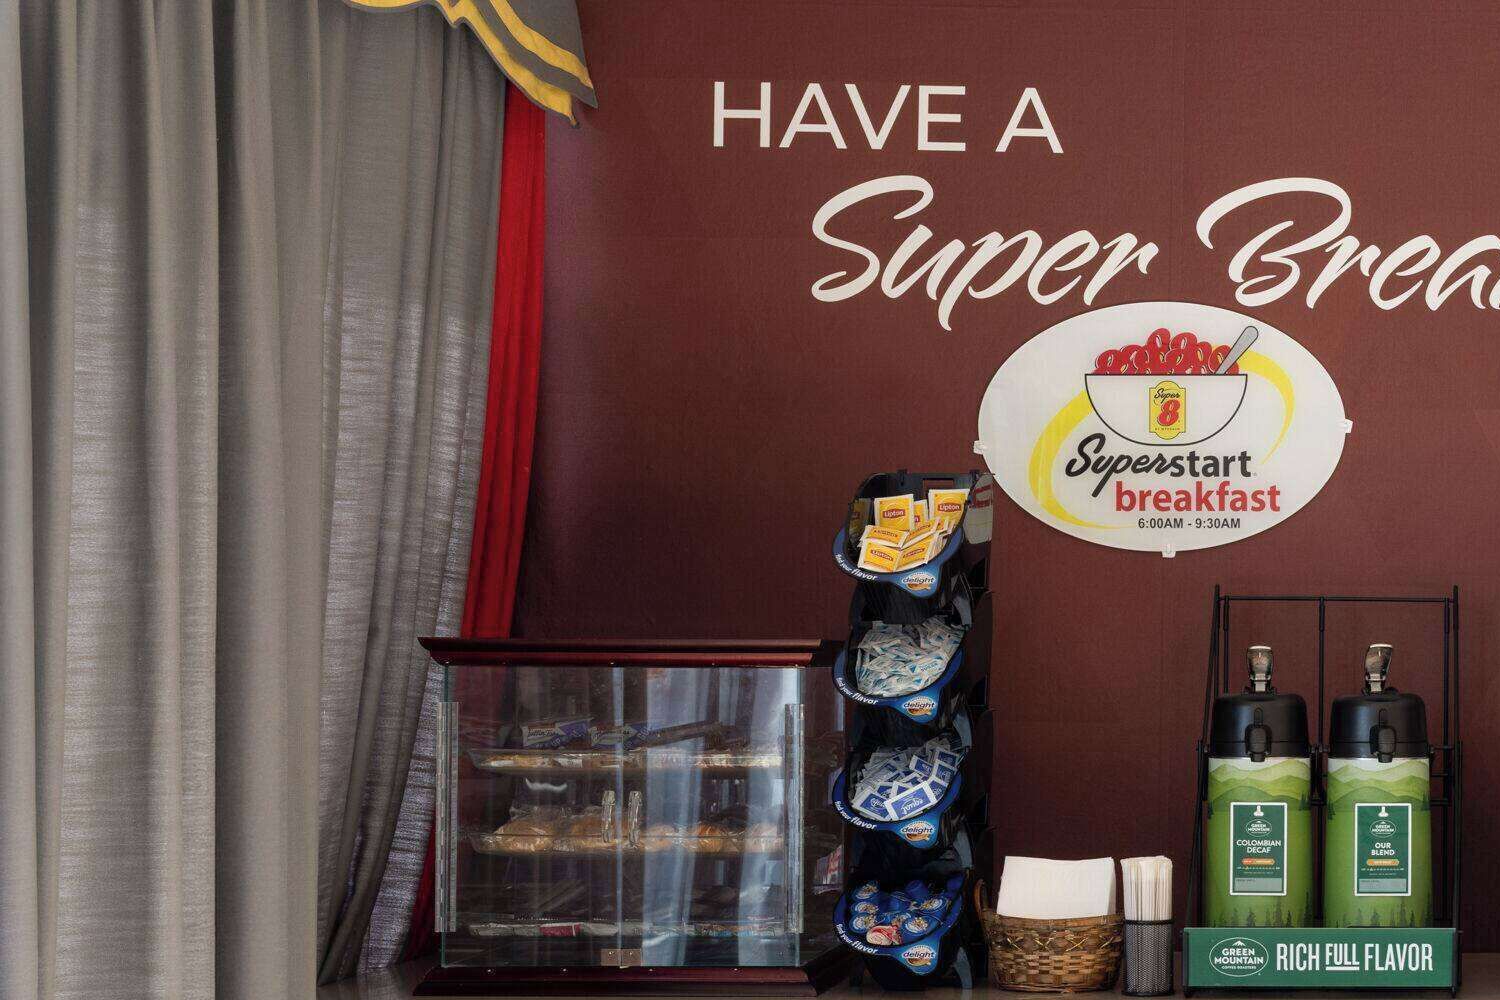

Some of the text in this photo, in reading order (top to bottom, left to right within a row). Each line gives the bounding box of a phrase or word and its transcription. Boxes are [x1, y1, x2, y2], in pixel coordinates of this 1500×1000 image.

[713, 81, 1064, 154] HAVE A
[811, 175, 1158, 331] Super
[1154, 388, 1181, 404] Super
[1157, 399, 1181, 426] 8
[1065, 432, 1252, 498] Superstart
[1116, 480, 1281, 512] breakfast
[884, 509, 905, 519] Lipton
[939, 503, 960, 513] Lipton
[1138, 517, 1184, 529] 6:00AM
[1196, 517, 1241, 529] 9:30AM
[851, 569, 878, 581] flavor
[902, 575, 936, 586] delight
[852, 692, 879, 705] flavor
[903, 700, 937, 711] delight
[850, 816, 877, 830] flavor
[901, 825, 935, 836] delight
[852, 940, 878, 954] flavor
[1221, 948, 1255, 956] GREEN
[902, 950, 937, 961] delight
[1214, 957, 1264, 965] MOUNTAIN
[1277, 943, 1434, 971] RICH FULL FLAVOR
